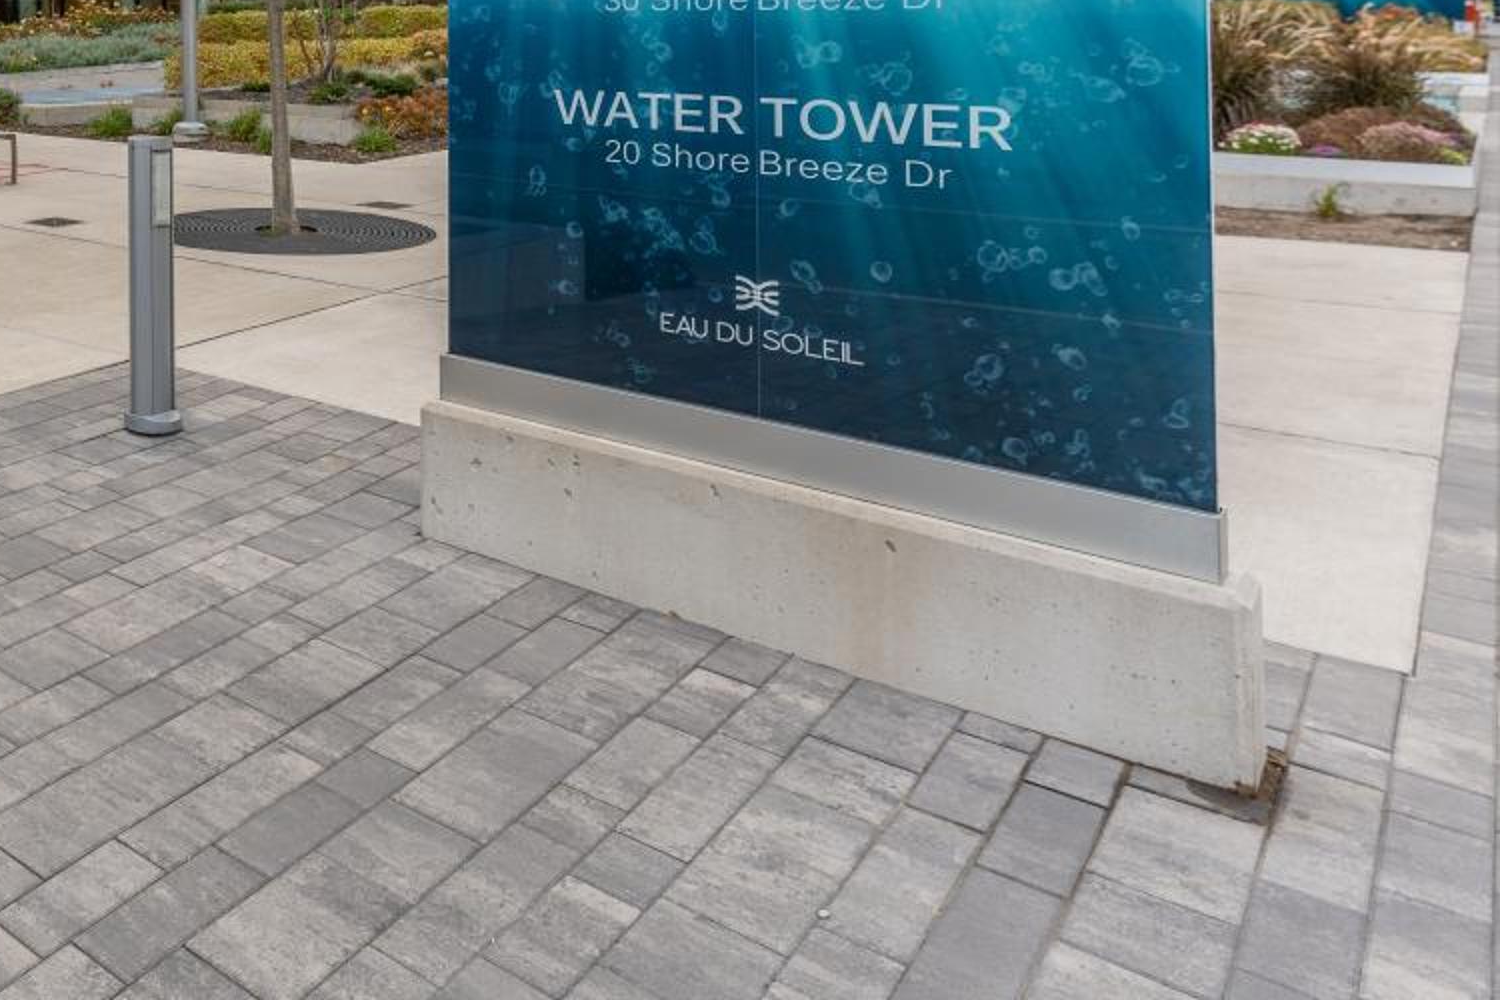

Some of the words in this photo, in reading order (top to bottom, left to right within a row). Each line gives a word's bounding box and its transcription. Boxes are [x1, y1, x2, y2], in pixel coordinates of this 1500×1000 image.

[554, 88, 745, 135] WATER
[759, 97, 1013, 151] TOWER
[605, 139, 642, 165] 20
[651, 143, 750, 174] Shore
[759, 150, 889, 185] Breeze
[904, 159, 954, 190] Dr
[659, 311, 709, 340] EAU
[715, 321, 754, 346] DU
[762, 328, 866, 366] SOLEIL
